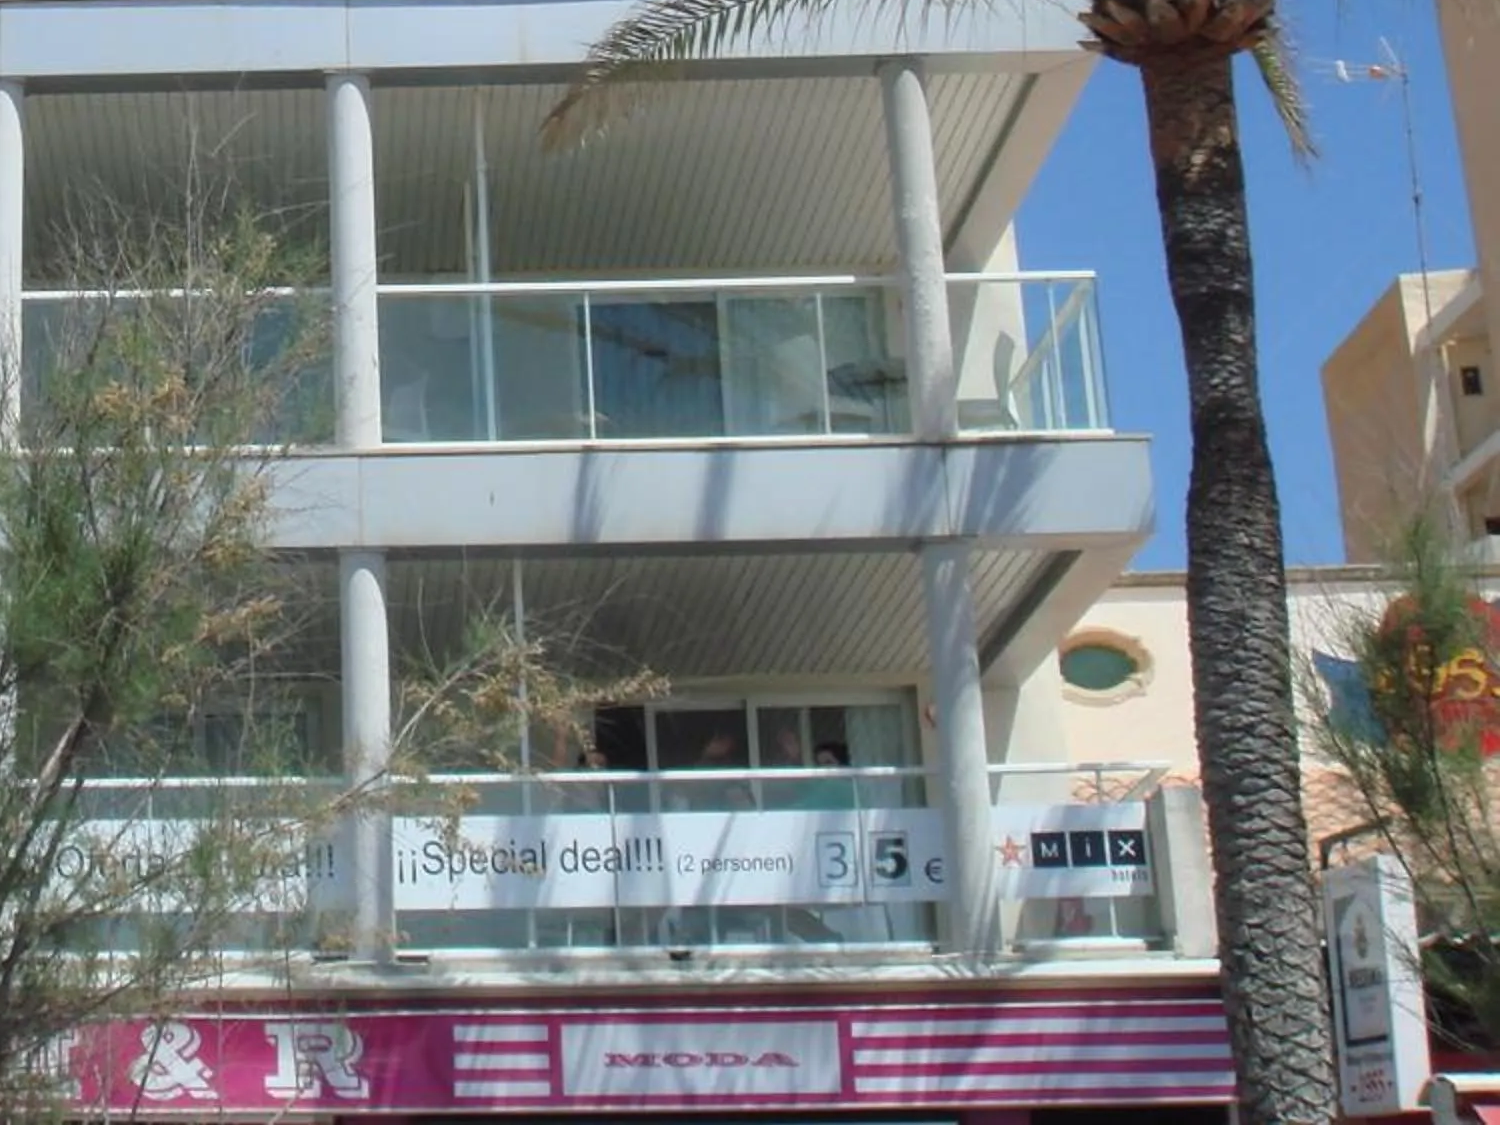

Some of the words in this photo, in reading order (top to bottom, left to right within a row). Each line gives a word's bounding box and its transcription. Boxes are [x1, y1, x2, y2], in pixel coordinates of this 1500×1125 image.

[559, 837, 665, 874] deal!!!
[700, 854, 794, 875] personen)
[603, 1051, 799, 1069] MODA
